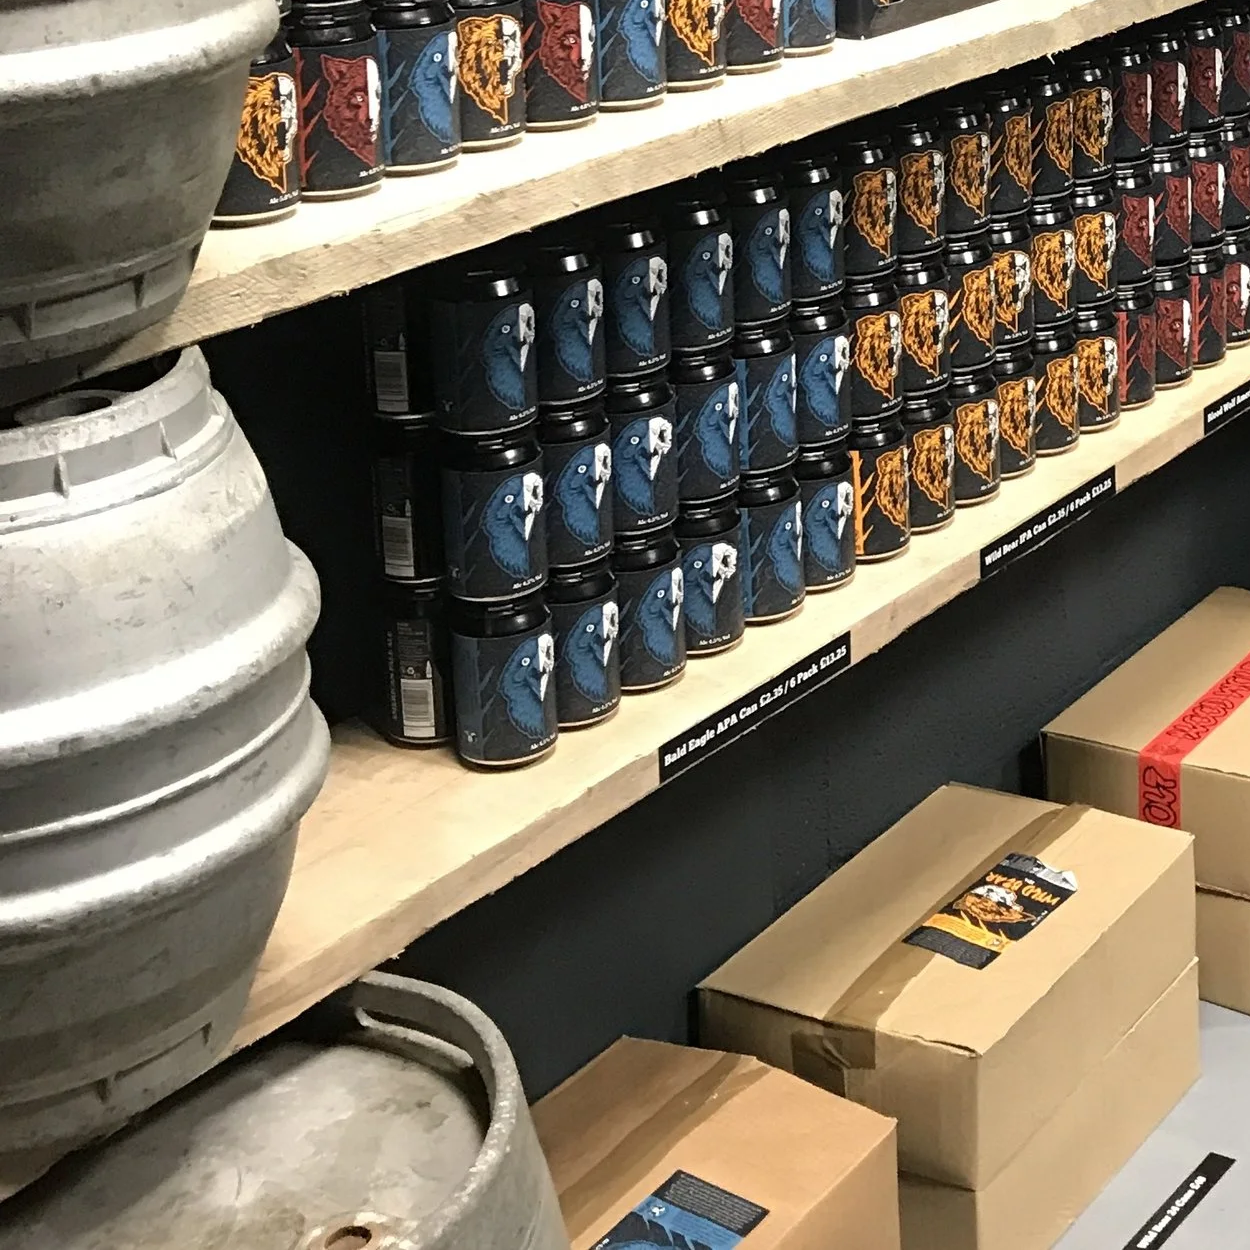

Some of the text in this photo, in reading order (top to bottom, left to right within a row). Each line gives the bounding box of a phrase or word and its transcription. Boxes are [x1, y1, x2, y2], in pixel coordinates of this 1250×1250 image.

[1207, 406, 1223, 423] Blood
[1223, 396, 1236, 413] Wolf
[984, 547, 1002, 566] Wild
[1002, 539, 1019, 556] Bear
[1019, 529, 1033, 545] IPA
[1032, 521, 1047, 535] Can
[1047, 507, 1066, 526] £2.35
[1075, 492, 1091, 509] Pack
[1091, 478, 1112, 498] £13.25
[664, 744, 687, 767] Bald
[688, 728, 715, 752] Eagle
[716, 714, 738, 735] APA
[739, 703, 758, 720] Can
[759, 684, 783, 708] £2.35
[796, 663, 819, 684] Pack
[819, 644, 847, 670] £13.25
[1142, 765, 1178, 828] OLF
[985, 871, 1061, 906] WILD BEAR
